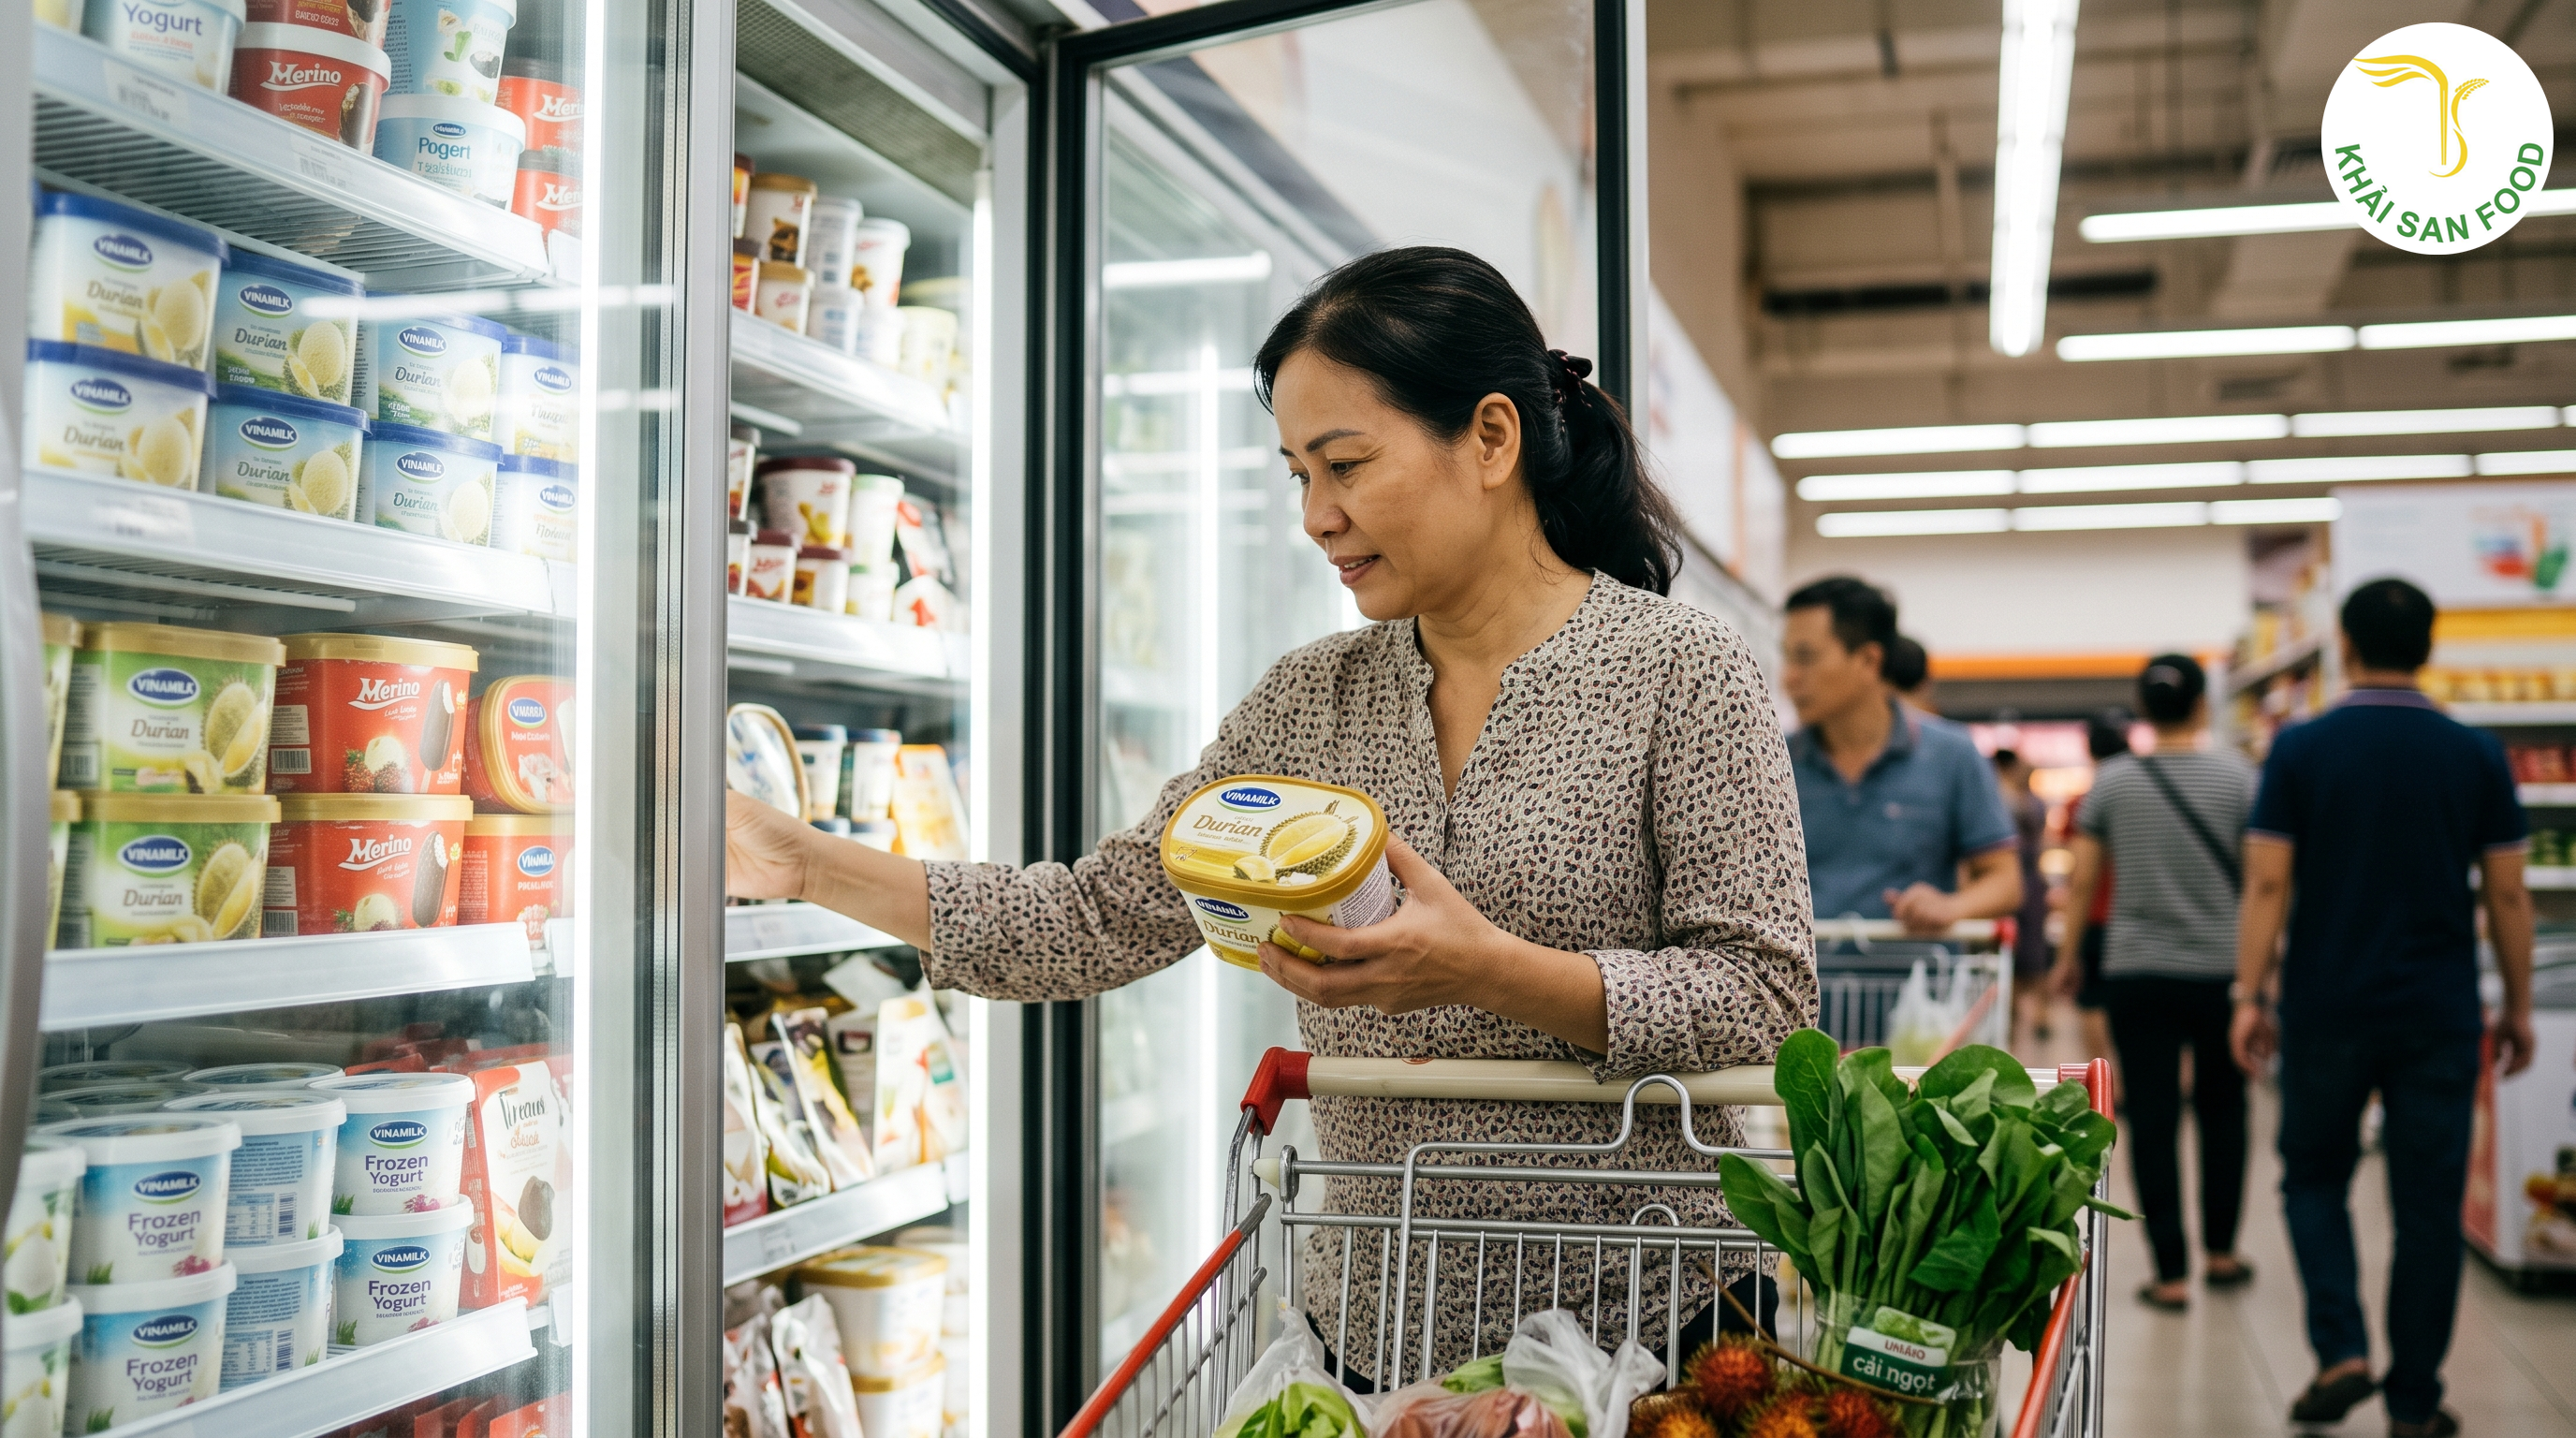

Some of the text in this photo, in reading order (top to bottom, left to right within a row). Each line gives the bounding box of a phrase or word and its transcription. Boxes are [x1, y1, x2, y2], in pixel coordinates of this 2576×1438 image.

[124, 3, 202, 37] Yogurt
[270, 61, 342, 85] Merino
[97, 238, 150, 261] VINAMILK
[86, 281, 143, 308] Durian
[243, 291, 291, 308] VINAMILK
[402, 332, 445, 349] VINAMILK
[395, 366, 442, 388] Durian
[74, 382, 129, 404] VINAMILK
[64, 426, 124, 452] Durian
[245, 424, 295, 440] VINAMILK
[237, 462, 290, 482] Durian
[393, 492, 439, 512] Durian
[135, 678, 195, 695] VINAMILK
[357, 678, 420, 702] Merino
[131, 718, 190, 740] Durian
[1226, 790, 1279, 806] VINAMILK
[1193, 814, 1263, 838] Durian
[124, 847, 187, 861] VINAMILK
[346, 833, 412, 863] Merino
[123, 888, 183, 907] Durian
[1203, 919, 1261, 944] Durian
[373, 1124, 425, 1138] VINAMILK
[365, 1154, 429, 1171] Frozen
[138, 1177, 198, 1194] VINAMILK
[370, 1170, 423, 1188] Yogurt
[128, 1211, 201, 1231] Frozen
[134, 1226, 195, 1248] Yogurt
[376, 1250, 427, 1264] VINAMILK
[369, 1279, 432, 1296] Frozen
[373, 1293, 427, 1312] Yogurt
[136, 1320, 197, 1339] VINAMILK
[126, 1353, 198, 1376] Frozen
[1852, 1354, 1937, 1393] cải ngọt
[132, 1369, 192, 1392] Yogurt
